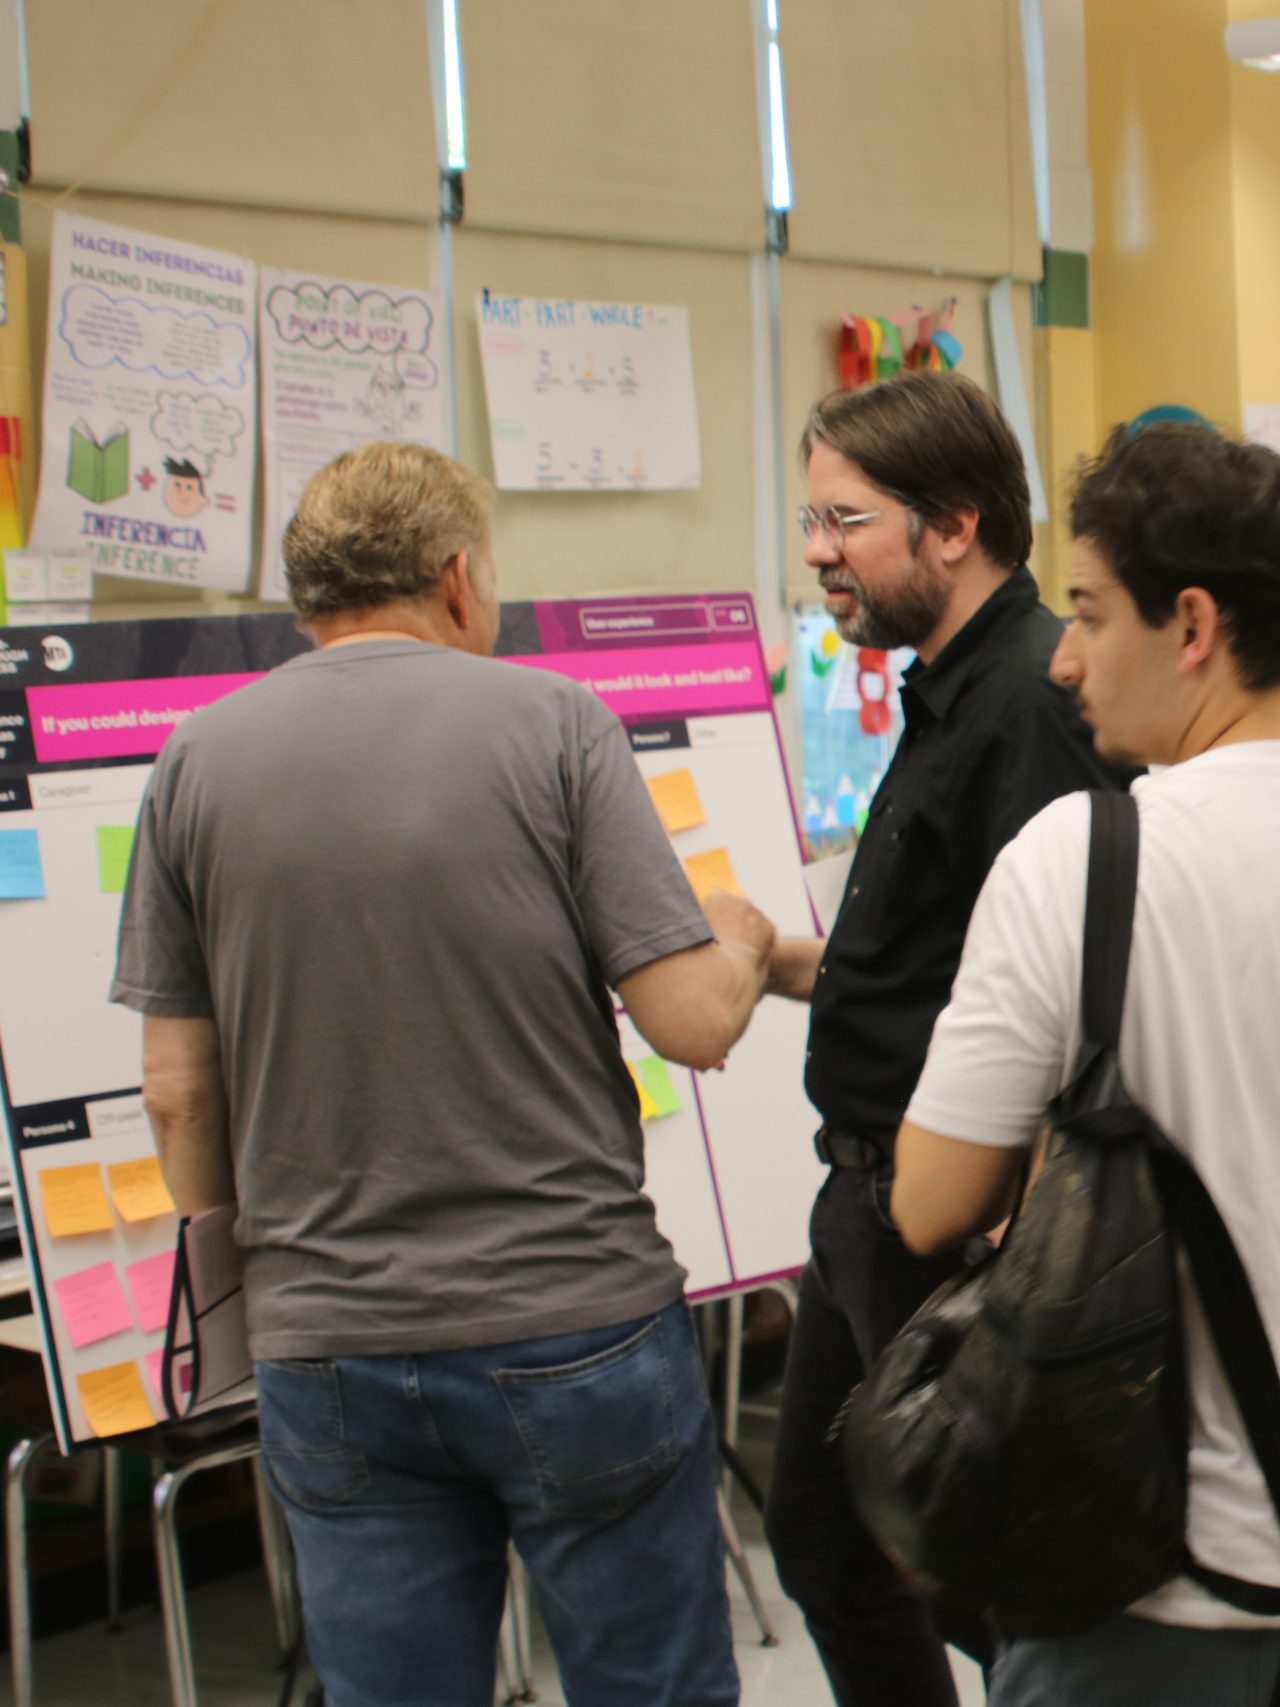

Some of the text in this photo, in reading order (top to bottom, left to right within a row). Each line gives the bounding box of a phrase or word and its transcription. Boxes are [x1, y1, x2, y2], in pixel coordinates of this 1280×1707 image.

[71, 231, 245, 285] HACER INFERENCIAS
[70, 262, 245, 315] MAKING INFERENCES
[344, 321, 361, 339] DE
[367, 326, 408, 345] VISTA
[81, 511, 207, 554] INFERENCIA
[88, 542, 200, 579] INFERENCE
[594, 676, 632, 693] would
[645, 671, 672, 688] look
[40, 716, 56, 733] If
[57, 717, 89, 736] you
[90, 710, 137, 730] could
[22, 1123, 66, 1138] Persona
